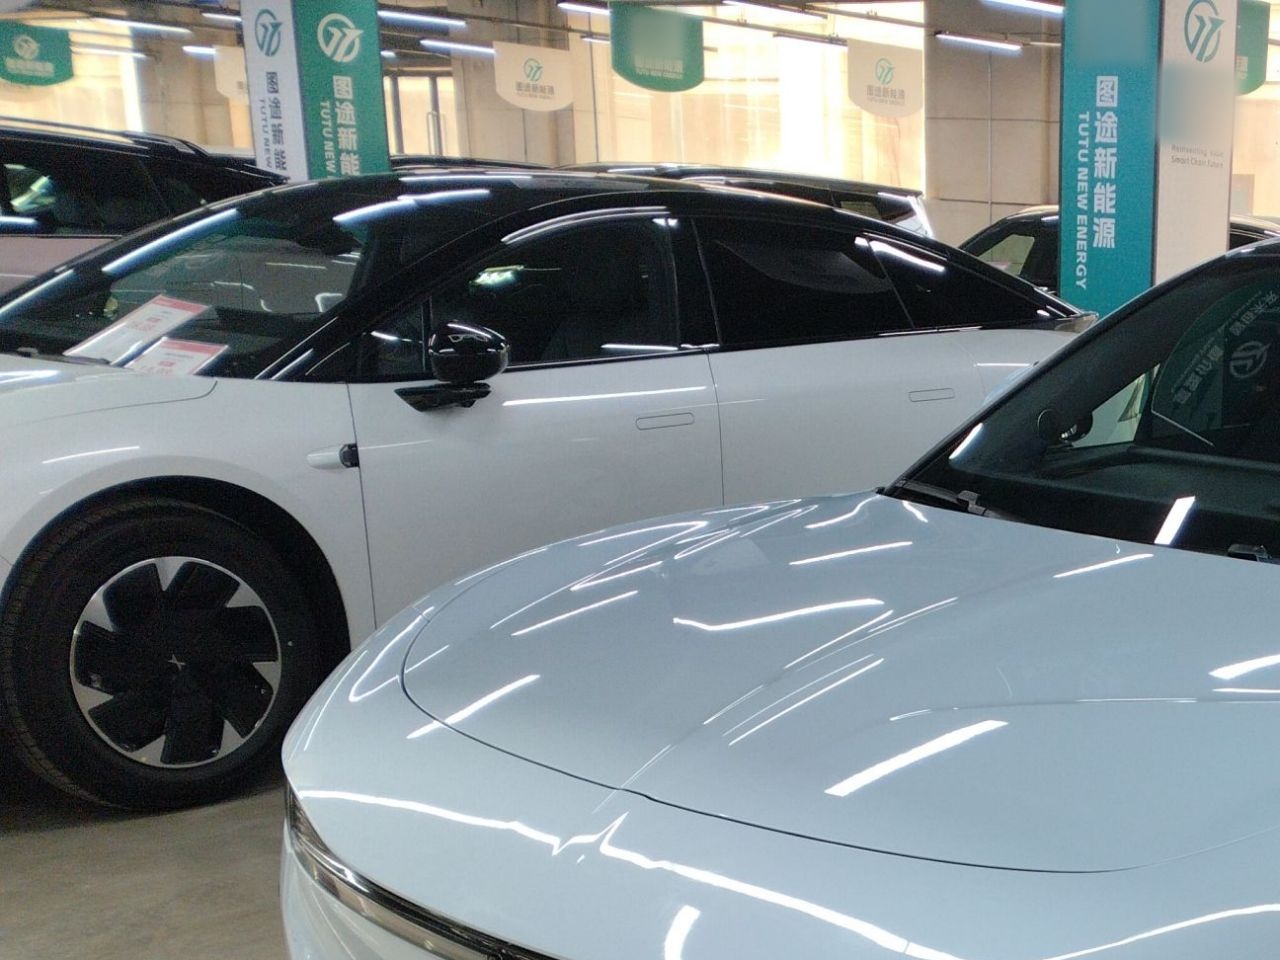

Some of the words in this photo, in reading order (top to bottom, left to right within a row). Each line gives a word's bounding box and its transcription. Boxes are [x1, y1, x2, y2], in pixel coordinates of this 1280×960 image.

[320, 100, 333, 137] TUTU
[1078, 111, 1089, 162] TUTU
[324, 140, 336, 173] NEW
[1093, 75, 1118, 248] 图途新能源
[1077, 168, 1088, 209] NEW
[1075, 215, 1088, 290] ENERGY
